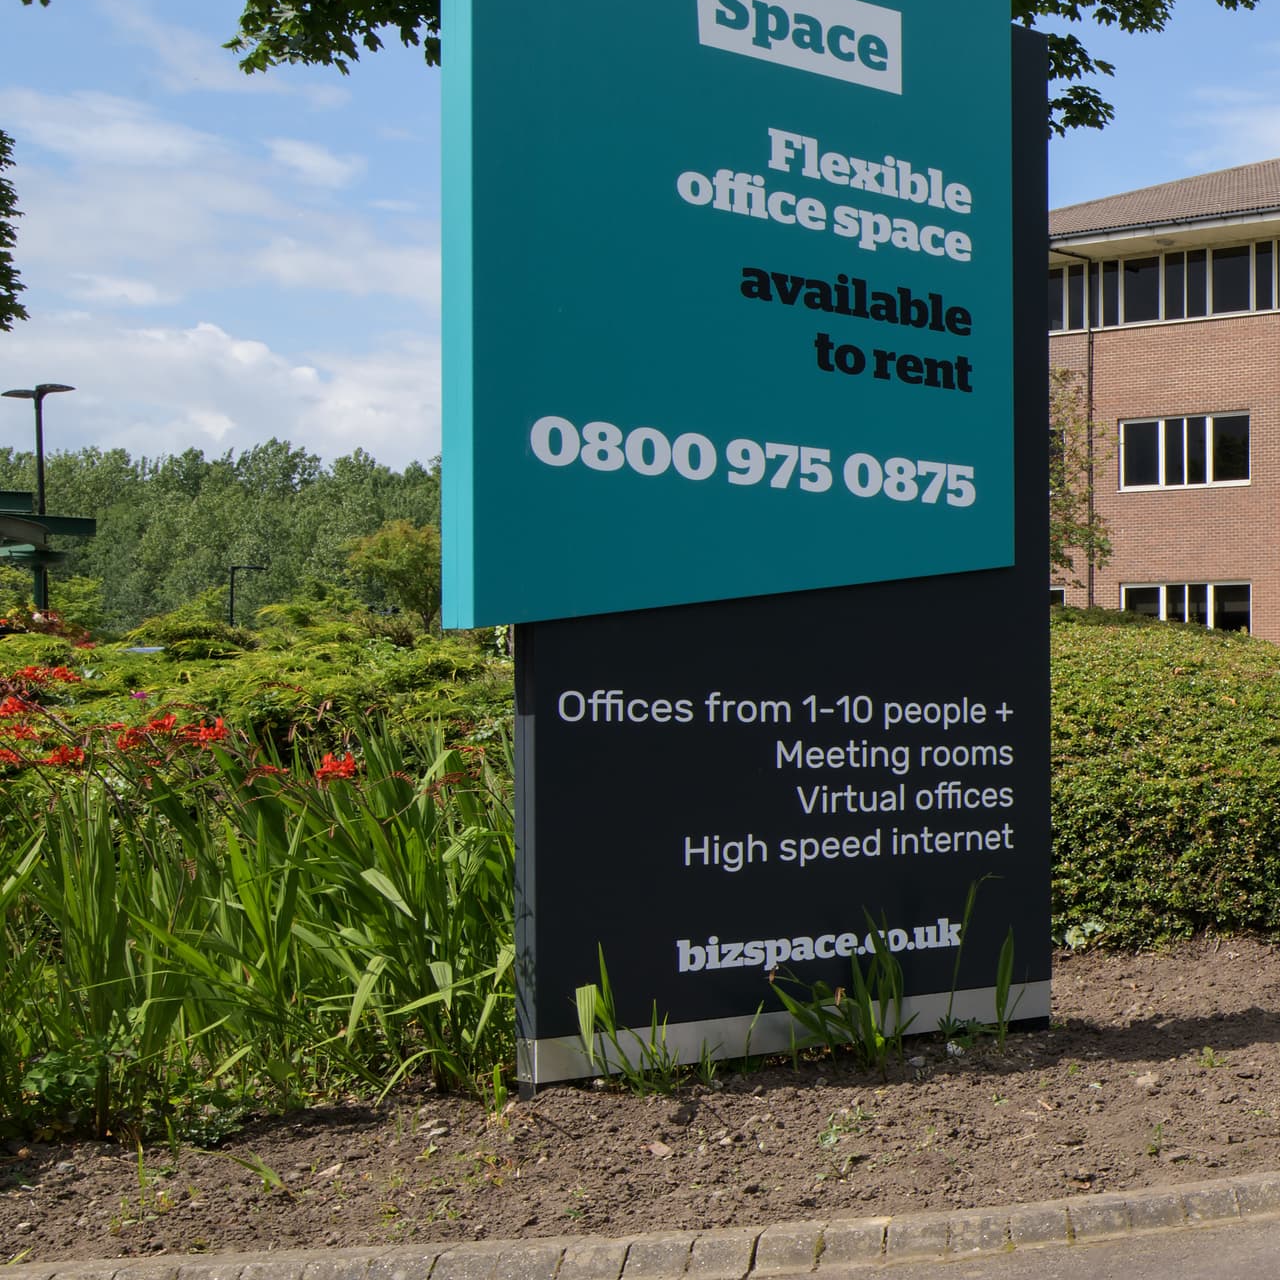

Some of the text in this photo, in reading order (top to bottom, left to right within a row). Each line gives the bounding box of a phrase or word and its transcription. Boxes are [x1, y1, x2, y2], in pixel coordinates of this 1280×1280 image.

[768, 127, 972, 214] Flexible
[677, 168, 972, 262] office space
[740, 267, 972, 337] available
[814, 332, 973, 393] to rent
[530, 416, 977, 508] 0800 975 0875
[558, 690, 694, 723] Offices
[704, 692, 792, 723] from
[802, 695, 873, 723] 1-10
[884, 697, 987, 730] people
[776, 740, 1014, 775] Meeting rooms
[797, 781, 1014, 814] Virtual offices
[685, 823, 1014, 873] High speed internet
